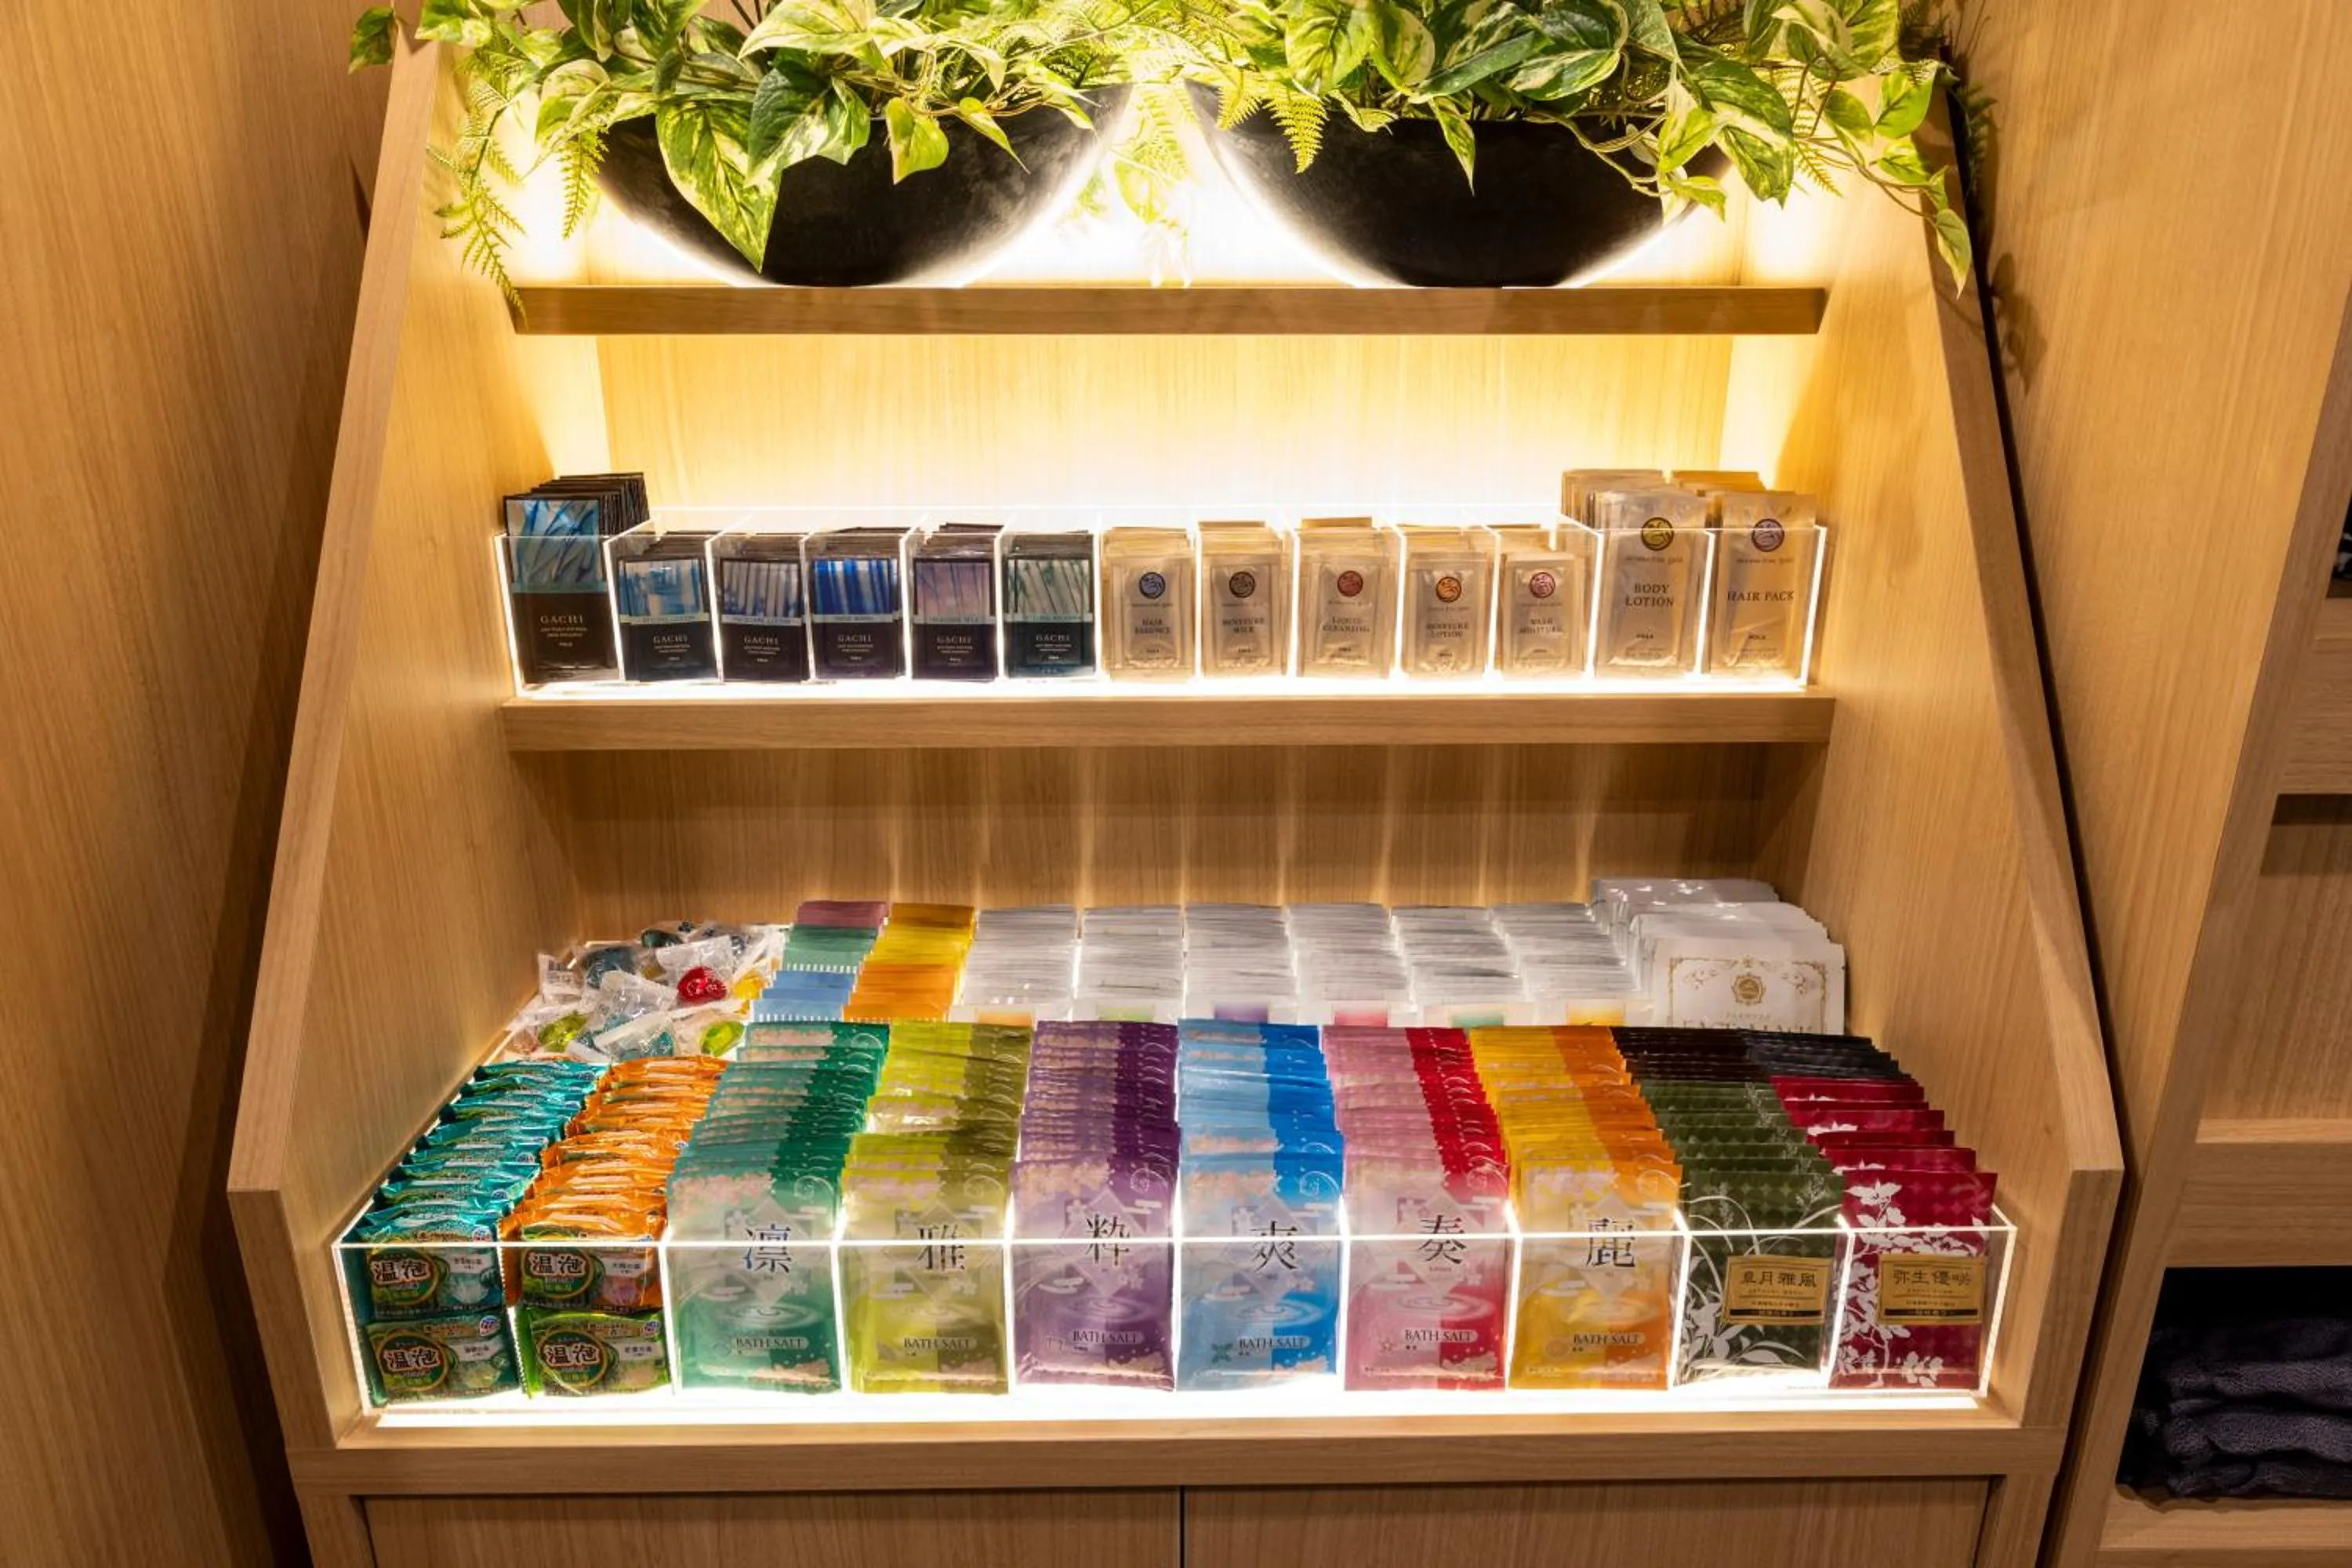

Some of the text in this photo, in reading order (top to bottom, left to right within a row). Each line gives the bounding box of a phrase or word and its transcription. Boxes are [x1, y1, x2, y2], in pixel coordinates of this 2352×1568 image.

[1633, 583, 1670, 595] BODY
[1727, 590, 1795, 602] HAIR PACK
[1625, 596, 1675, 608] LOTION
[916, 1223, 966, 1272] 雅
[1085, 1214, 1131, 1267] 粋
[1250, 1220, 1299, 1272] 爽
[1418, 1214, 1467, 1265] 奏
[1586, 1218, 1636, 1269] 麗
[375, 1259, 428, 1282] 温泡
[532, 1254, 583, 1274] 温泡
[735, 1337, 803, 1348] BATH SALT
[1073, 1330, 1138, 1344] BATH SALT
[1404, 1329, 1472, 1341] BATH SALT
[1573, 1334, 1639, 1345] BATH SALT
[904, 1338, 971, 1349] BATH SALT
[1239, 1338, 1305, 1349] BATH SALT
[387, 1347, 438, 1369] 温泡
[548, 1345, 598, 1364] 温泡
